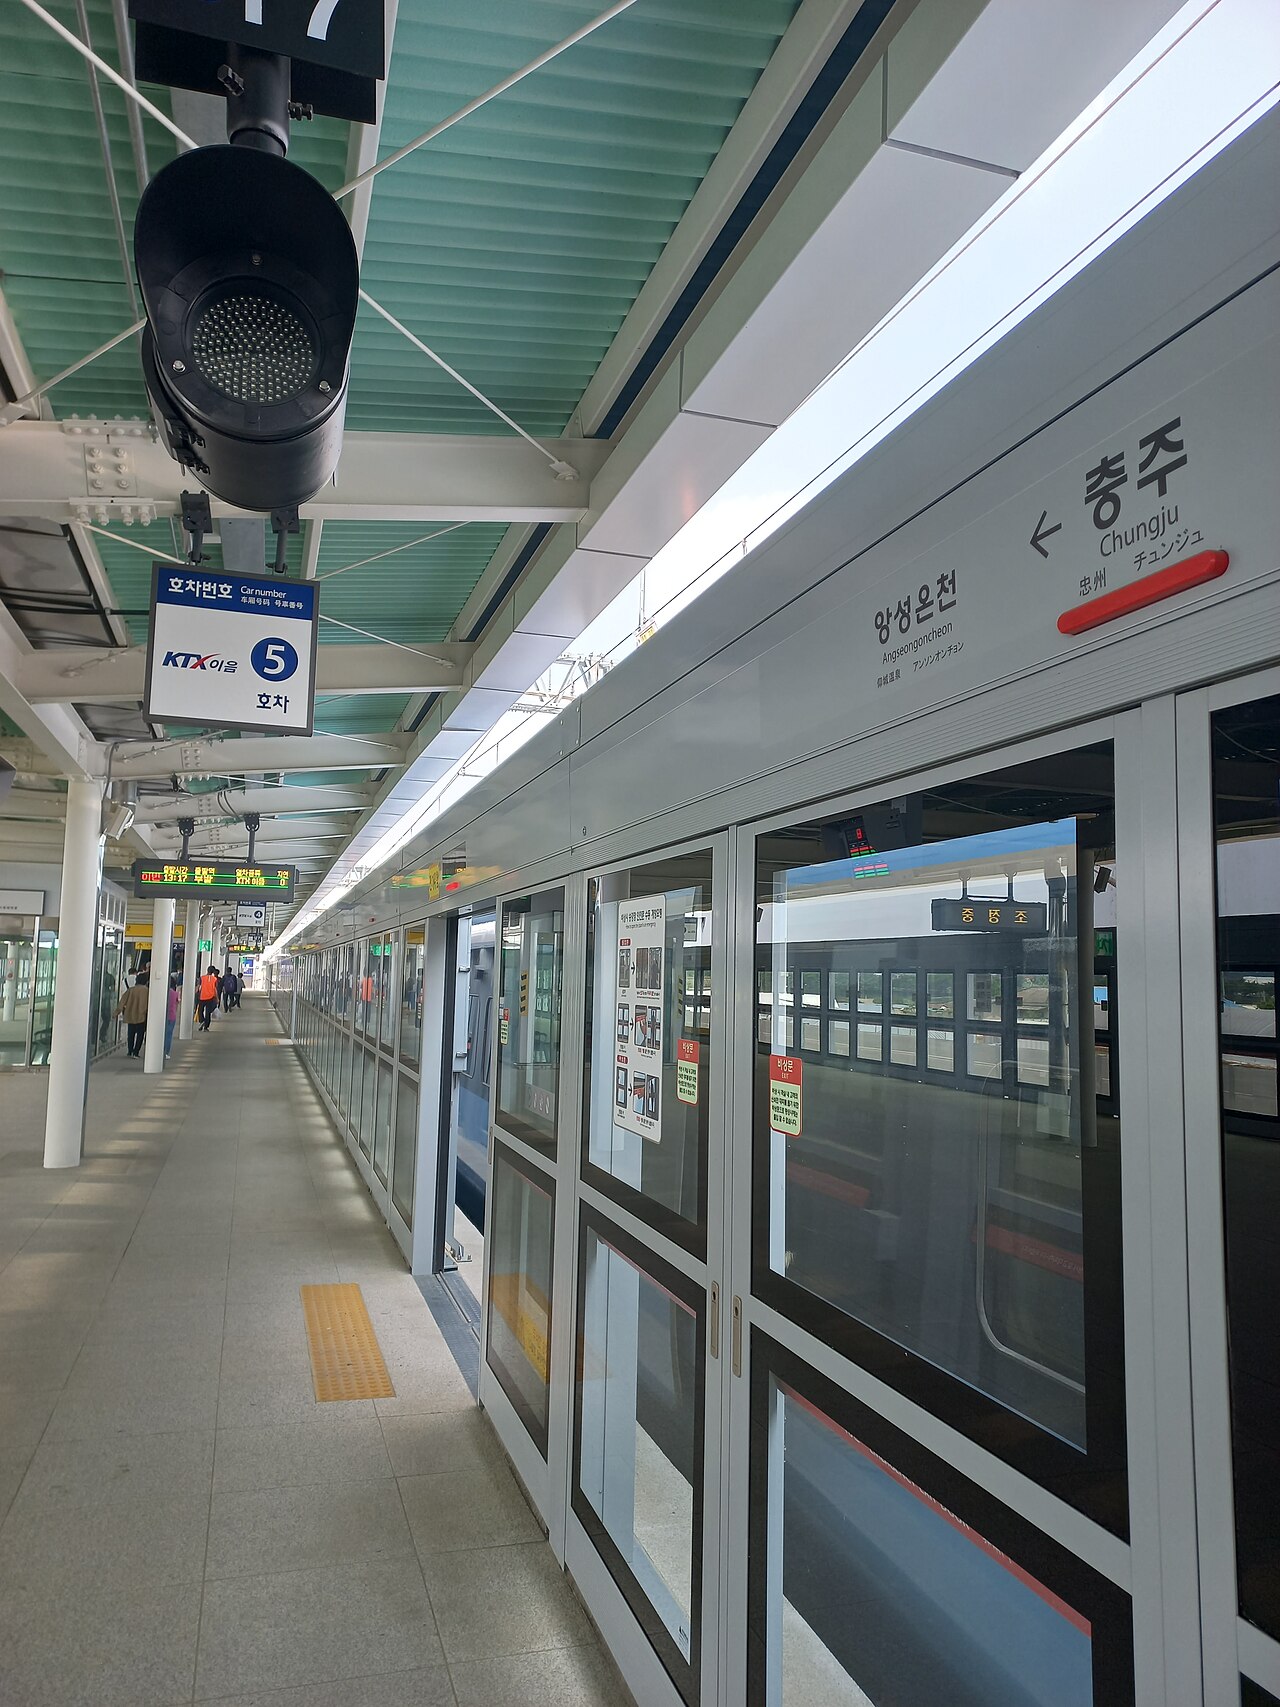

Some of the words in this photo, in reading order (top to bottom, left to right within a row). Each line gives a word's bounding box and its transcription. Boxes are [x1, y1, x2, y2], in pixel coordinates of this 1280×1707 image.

[1084, 416, 1188, 530] 충주
[1100, 505, 1179, 557] Chungju
[1133, 528, 1204, 571] チュンジュ
[168, 577, 233, 600] 호차번호
[240, 585, 256, 595] Car
[256, 588, 287, 599] number
[1079, 567, 1107, 597] 忠州
[874, 568, 957, 645] 앙성온천
[882, 622, 953, 665] Angseongoncheon
[263, 644, 285, 675] 5
[256, 692, 290, 714] 호차
[164, 874, 188, 882] 13:17
[777, 1058, 793, 1073] 비상문
